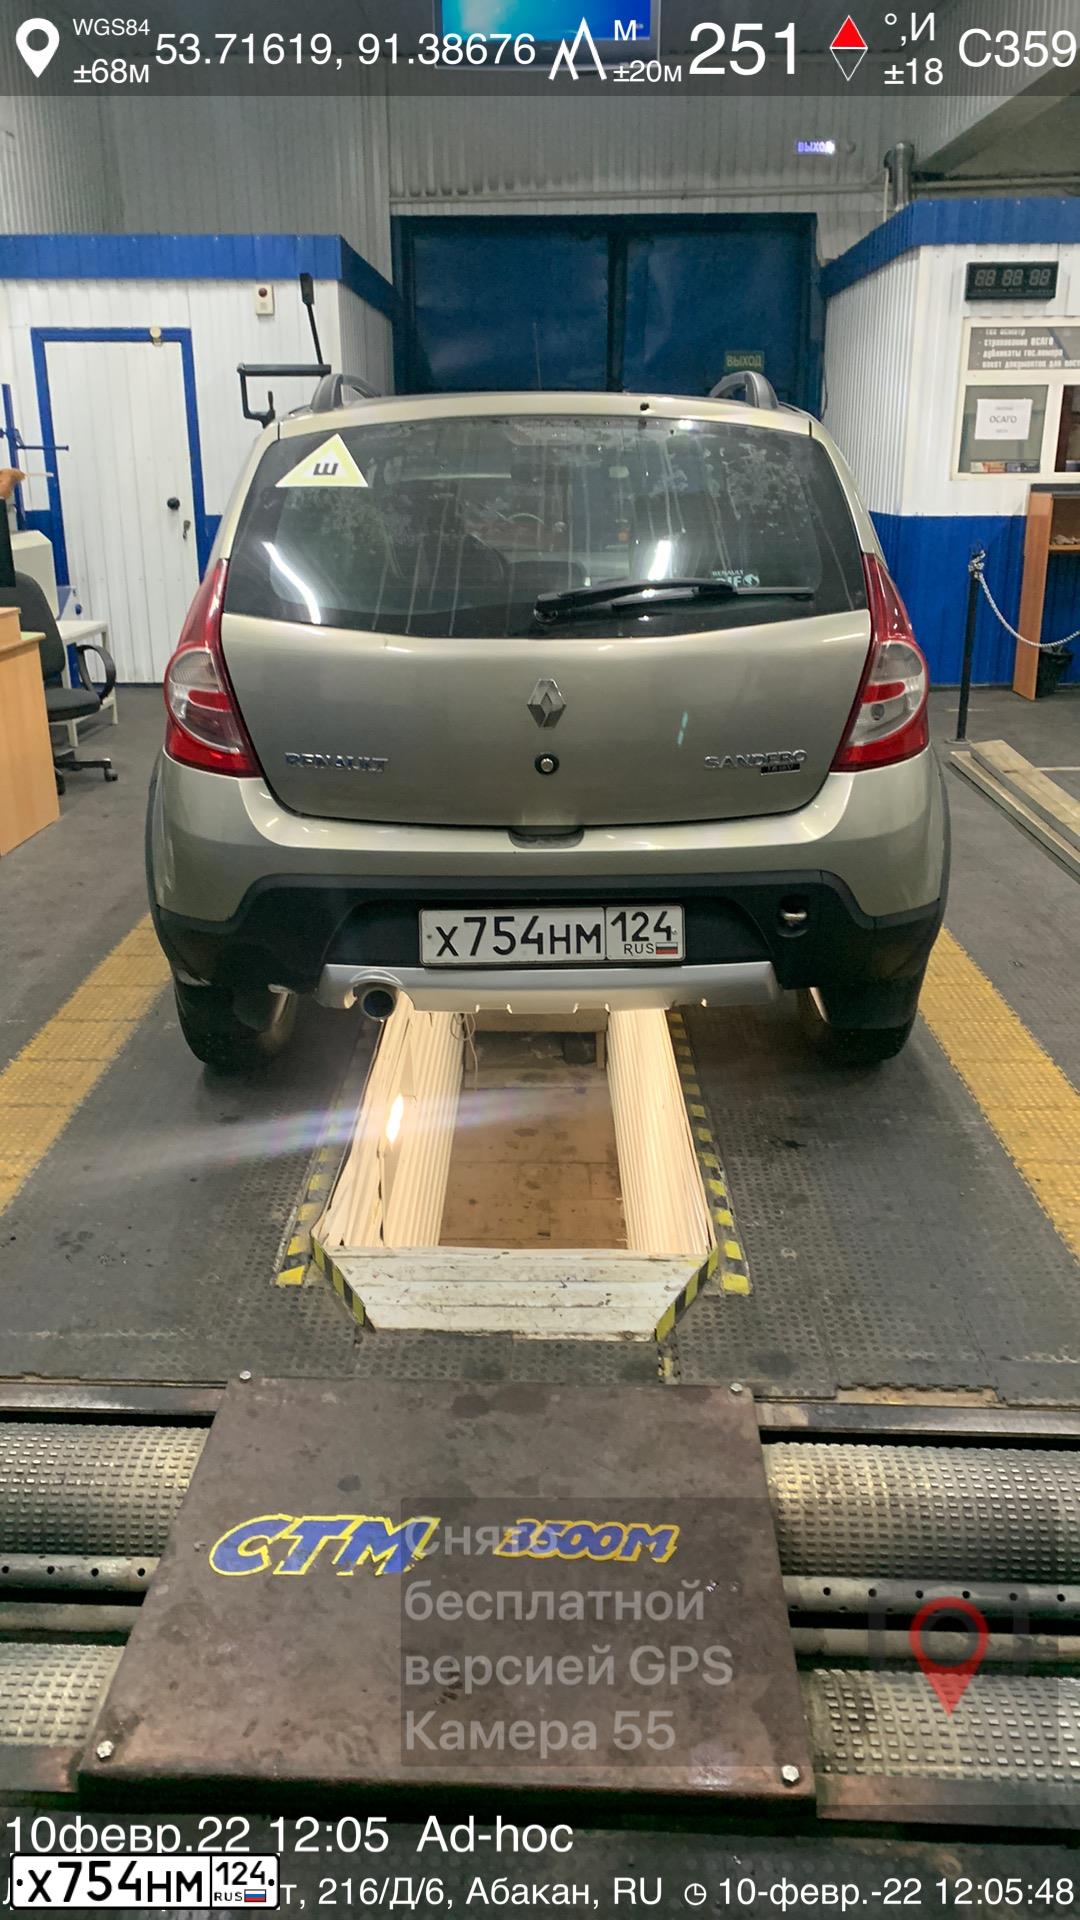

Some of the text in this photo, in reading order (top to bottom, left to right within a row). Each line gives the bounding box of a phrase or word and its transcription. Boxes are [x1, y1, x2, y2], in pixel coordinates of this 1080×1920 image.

[1030, 336, 1054, 346] ОСАГО
[726, 355, 762, 368] ВЫХОД
[989, 415, 1018, 424] ОСАГО
[284, 752, 389, 773] RENAULT
[704, 749, 808, 769] SANDERO
[610, 910, 673, 943] 124
[623, 943, 655, 956] RUS
